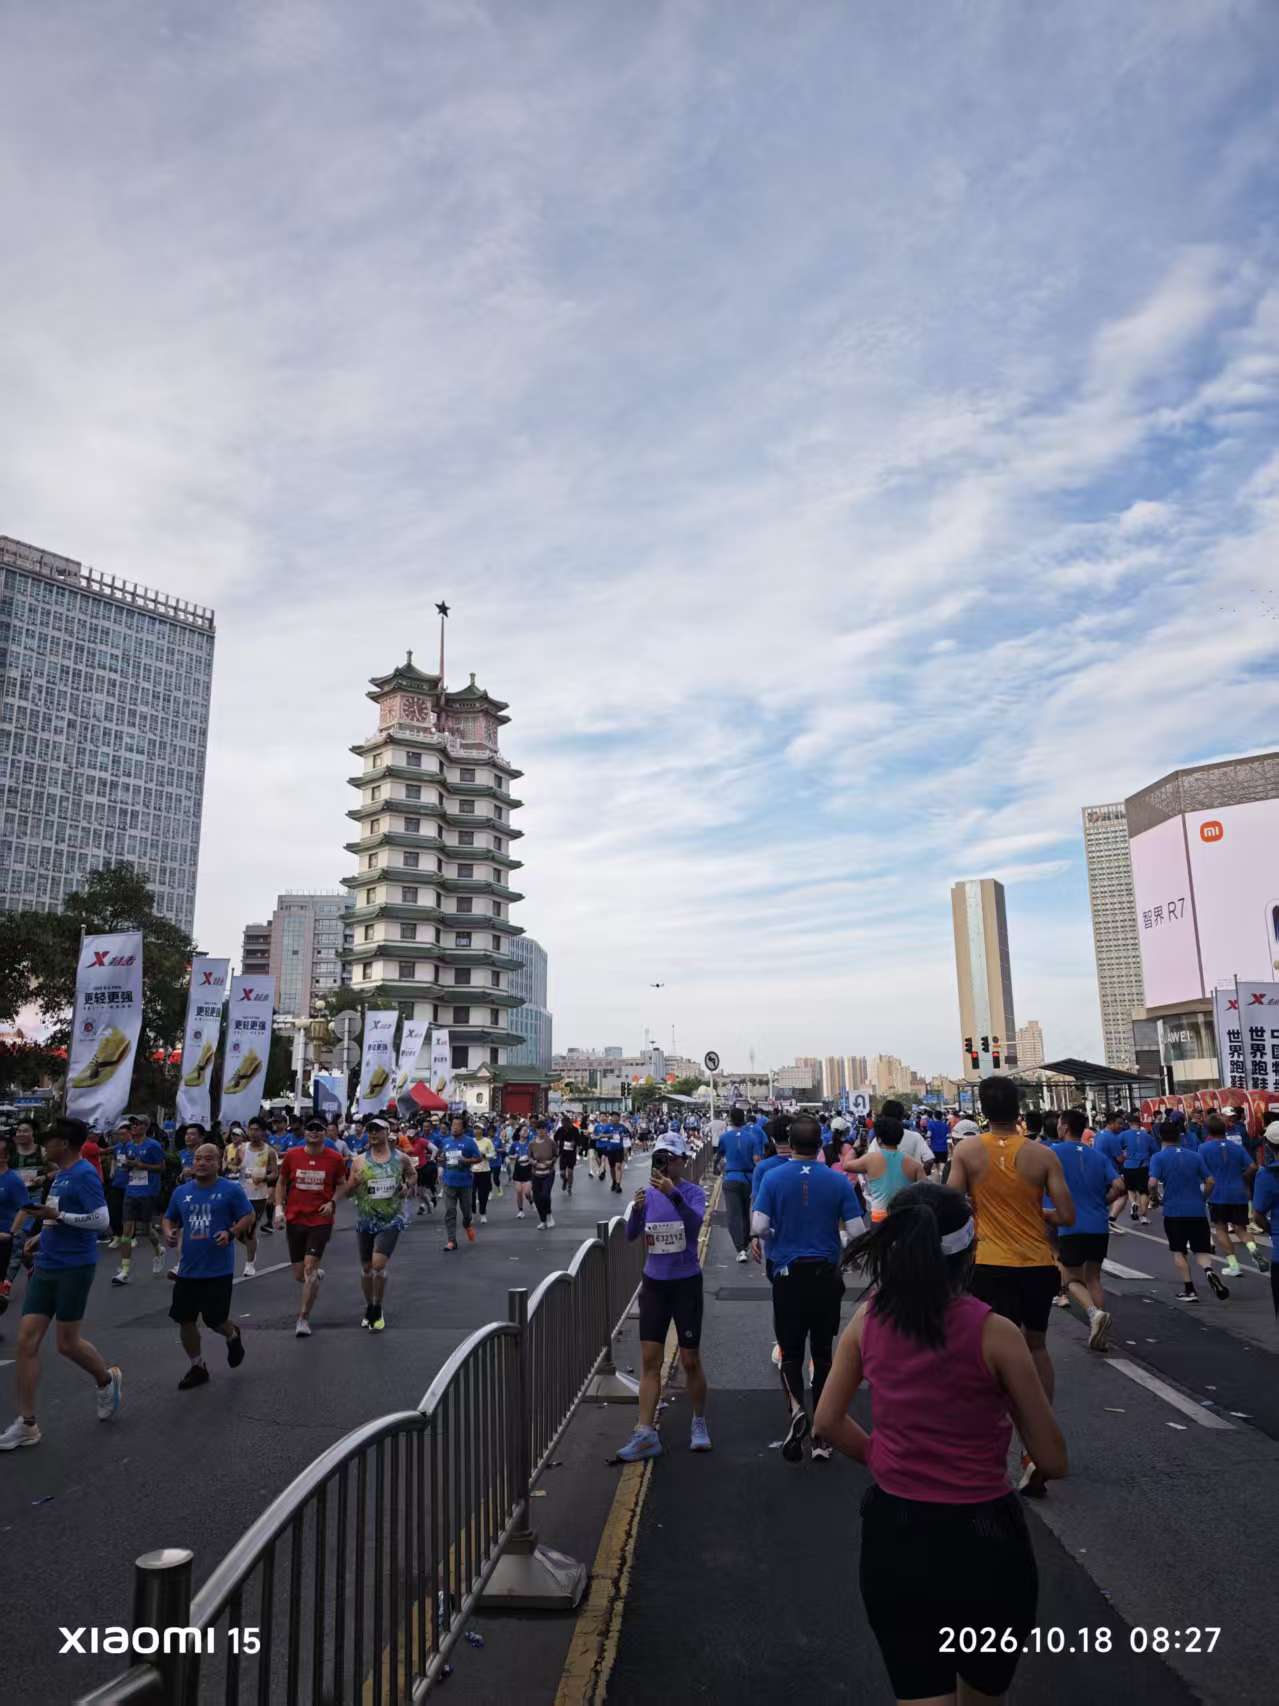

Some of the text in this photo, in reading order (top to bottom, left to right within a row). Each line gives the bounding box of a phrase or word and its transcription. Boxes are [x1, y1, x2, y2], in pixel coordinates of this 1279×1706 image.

[1142, 897, 1185, 929] 智界 R7
[83, 990, 134, 1005] 更轻更强
